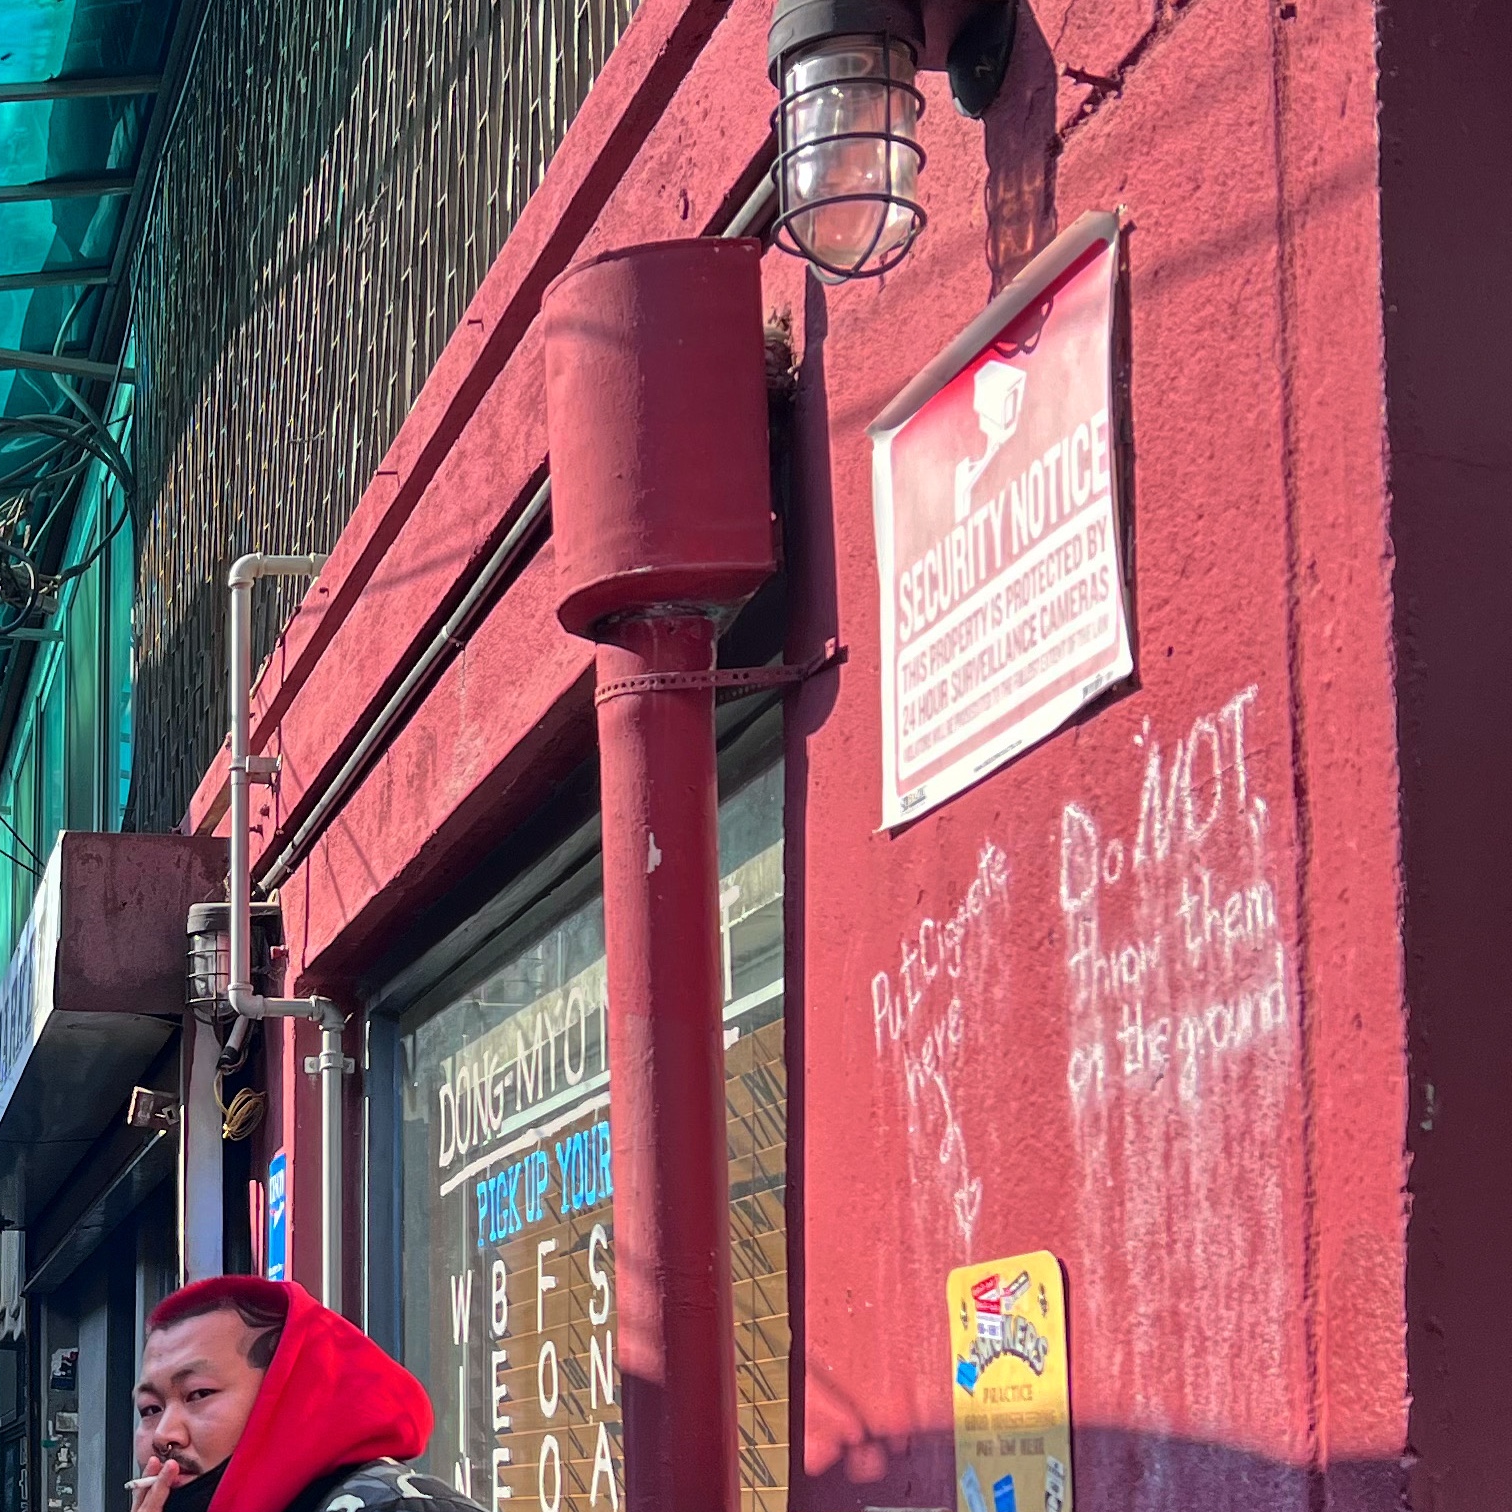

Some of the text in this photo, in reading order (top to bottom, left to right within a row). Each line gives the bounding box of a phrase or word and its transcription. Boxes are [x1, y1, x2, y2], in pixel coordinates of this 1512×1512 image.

[899, 406, 1110, 643] SECURITY NOTICE
[902, 652, 928, 695] THIS
[929, 602, 988, 677] PROPERTY
[991, 592, 1003, 629] IS
[1005, 533, 1083, 619] PROTECTED
[1086, 514, 1108, 561] BY
[902, 702, 916, 737] 24
[918, 679, 949, 727] HOUR
[951, 613, 1038, 704] SURVEILLANCE
[1040, 564, 1109, 641] CAMERAS
[476, 1120, 614, 1248] PICK UP YOUR
[451, 1269, 473, 1499] WIN
